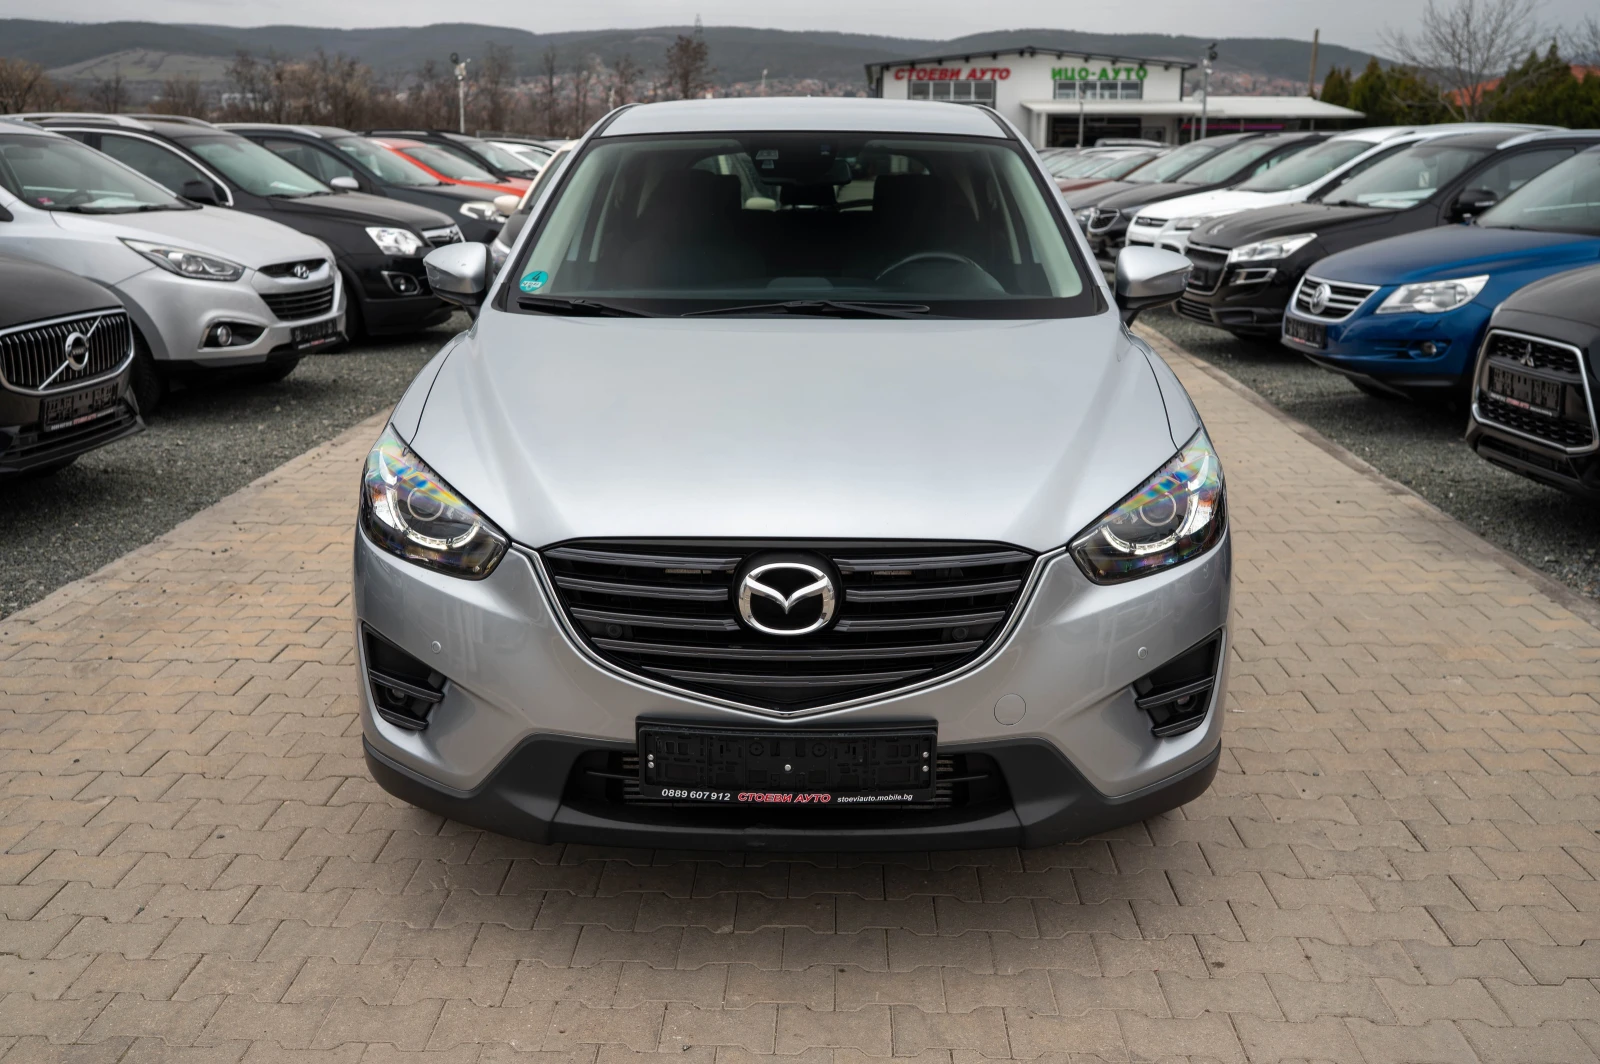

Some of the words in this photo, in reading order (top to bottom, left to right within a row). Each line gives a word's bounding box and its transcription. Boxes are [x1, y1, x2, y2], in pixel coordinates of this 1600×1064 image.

[894, 67, 961, 80] СТОЕВИ
[966, 67, 1011, 80] АУТО
[1051, 67, 1148, 81] ИЦО-АУТО
[532, 271, 542, 281] 4
[661, 788, 688, 798] 0889
[690, 790, 710, 800] 607
[710, 792, 731, 801] 912
[737, 792, 793, 803] СТОЕВИ
[794, 793, 831, 803] АУТО
[837, 793, 914, 803] stoeviauto.mobile.bg
